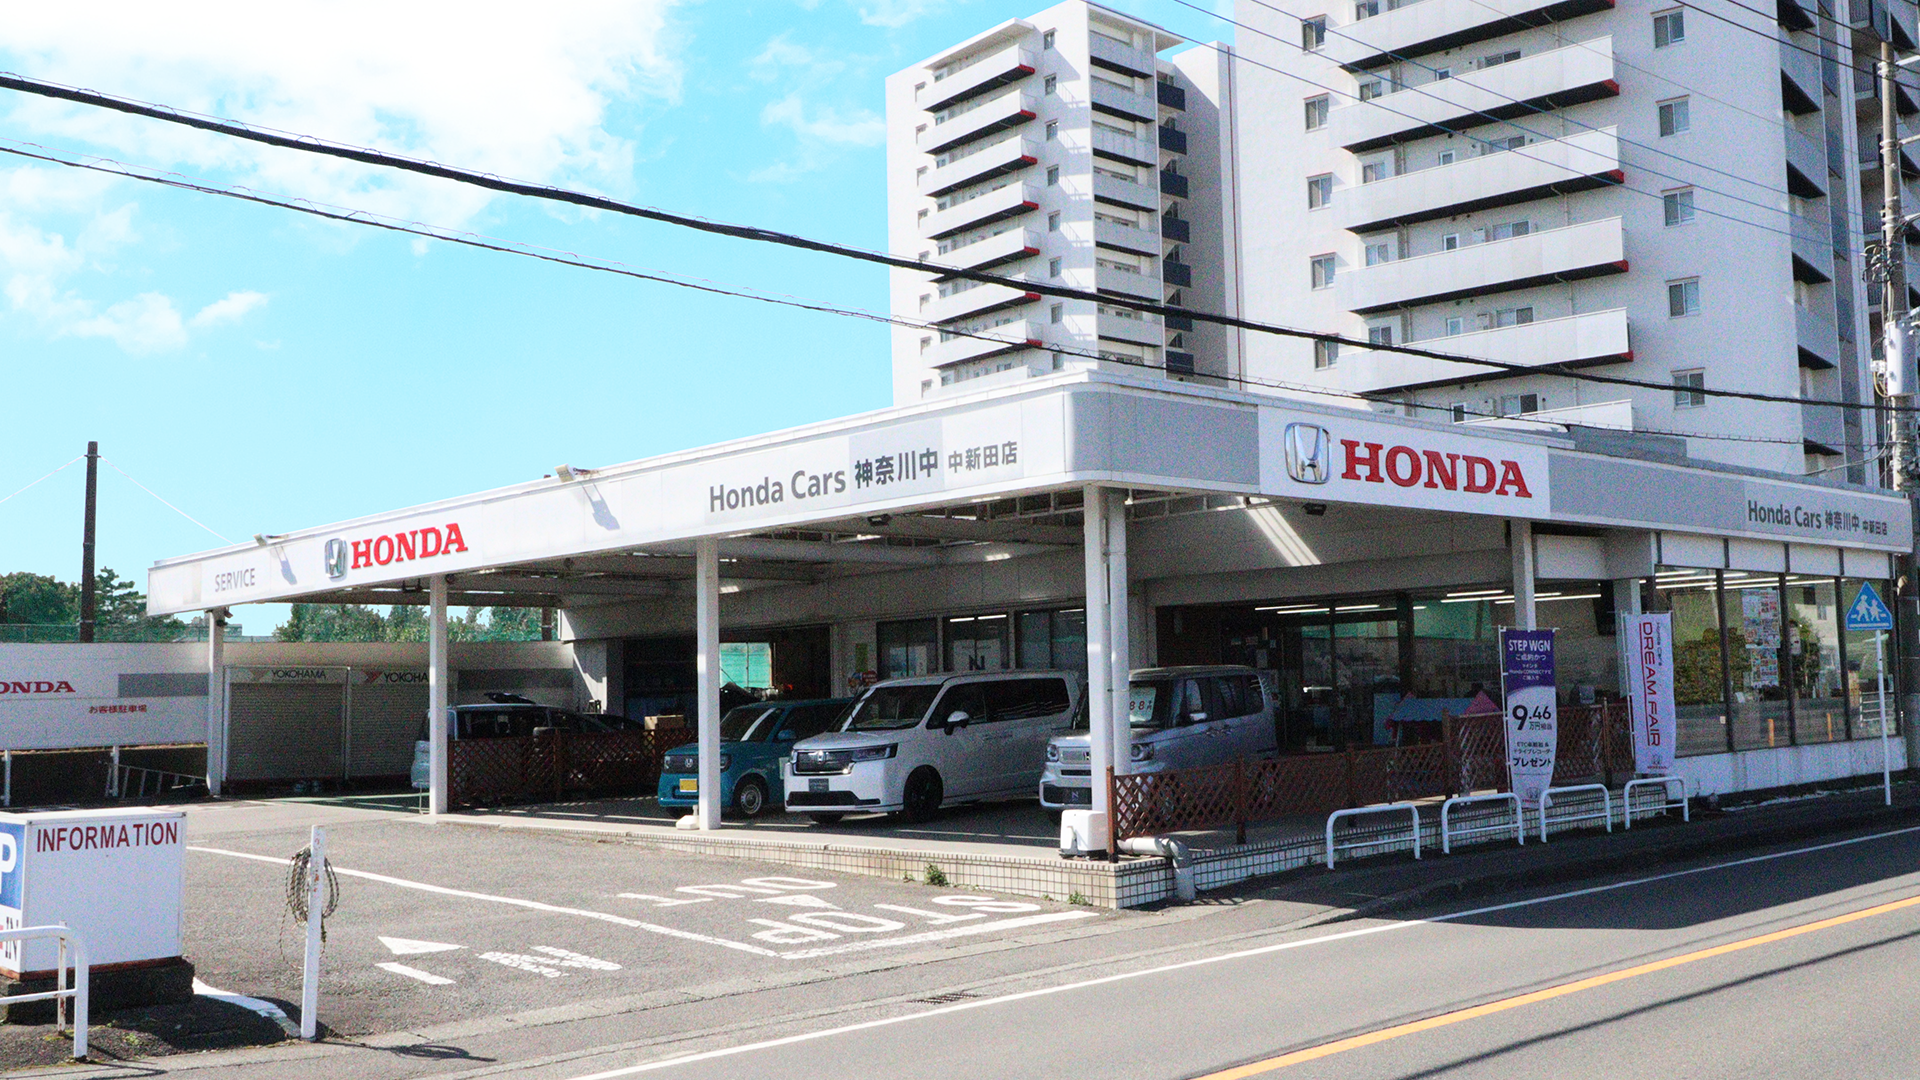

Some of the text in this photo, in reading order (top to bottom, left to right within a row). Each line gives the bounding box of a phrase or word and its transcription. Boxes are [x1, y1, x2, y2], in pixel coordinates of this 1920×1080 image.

[709, 441, 1018, 512] Honda Cars 神奈川中 中新田店
[1340, 438, 1533, 498] HONDA
[1747, 499, 1791, 526] Honda
[1794, 505, 1822, 529] Cars
[1824, 509, 1860, 532] 神奈川中
[351, 522, 468, 569] HONDA
[214, 568, 256, 592] SERVICE
[1508, 640, 1551, 651] STEP WGN
[271, 669, 327, 681] YOKOHAMA
[1642, 621, 1661, 747] DREAM FAIR
[89, 704, 148, 715] お客様駐車場
[1512, 704, 1552, 731] 9.46
[1512, 757, 1552, 768] プレゼント
[37, 822, 178, 852] INFORMATION
[745, 894, 1041, 944] STOP
